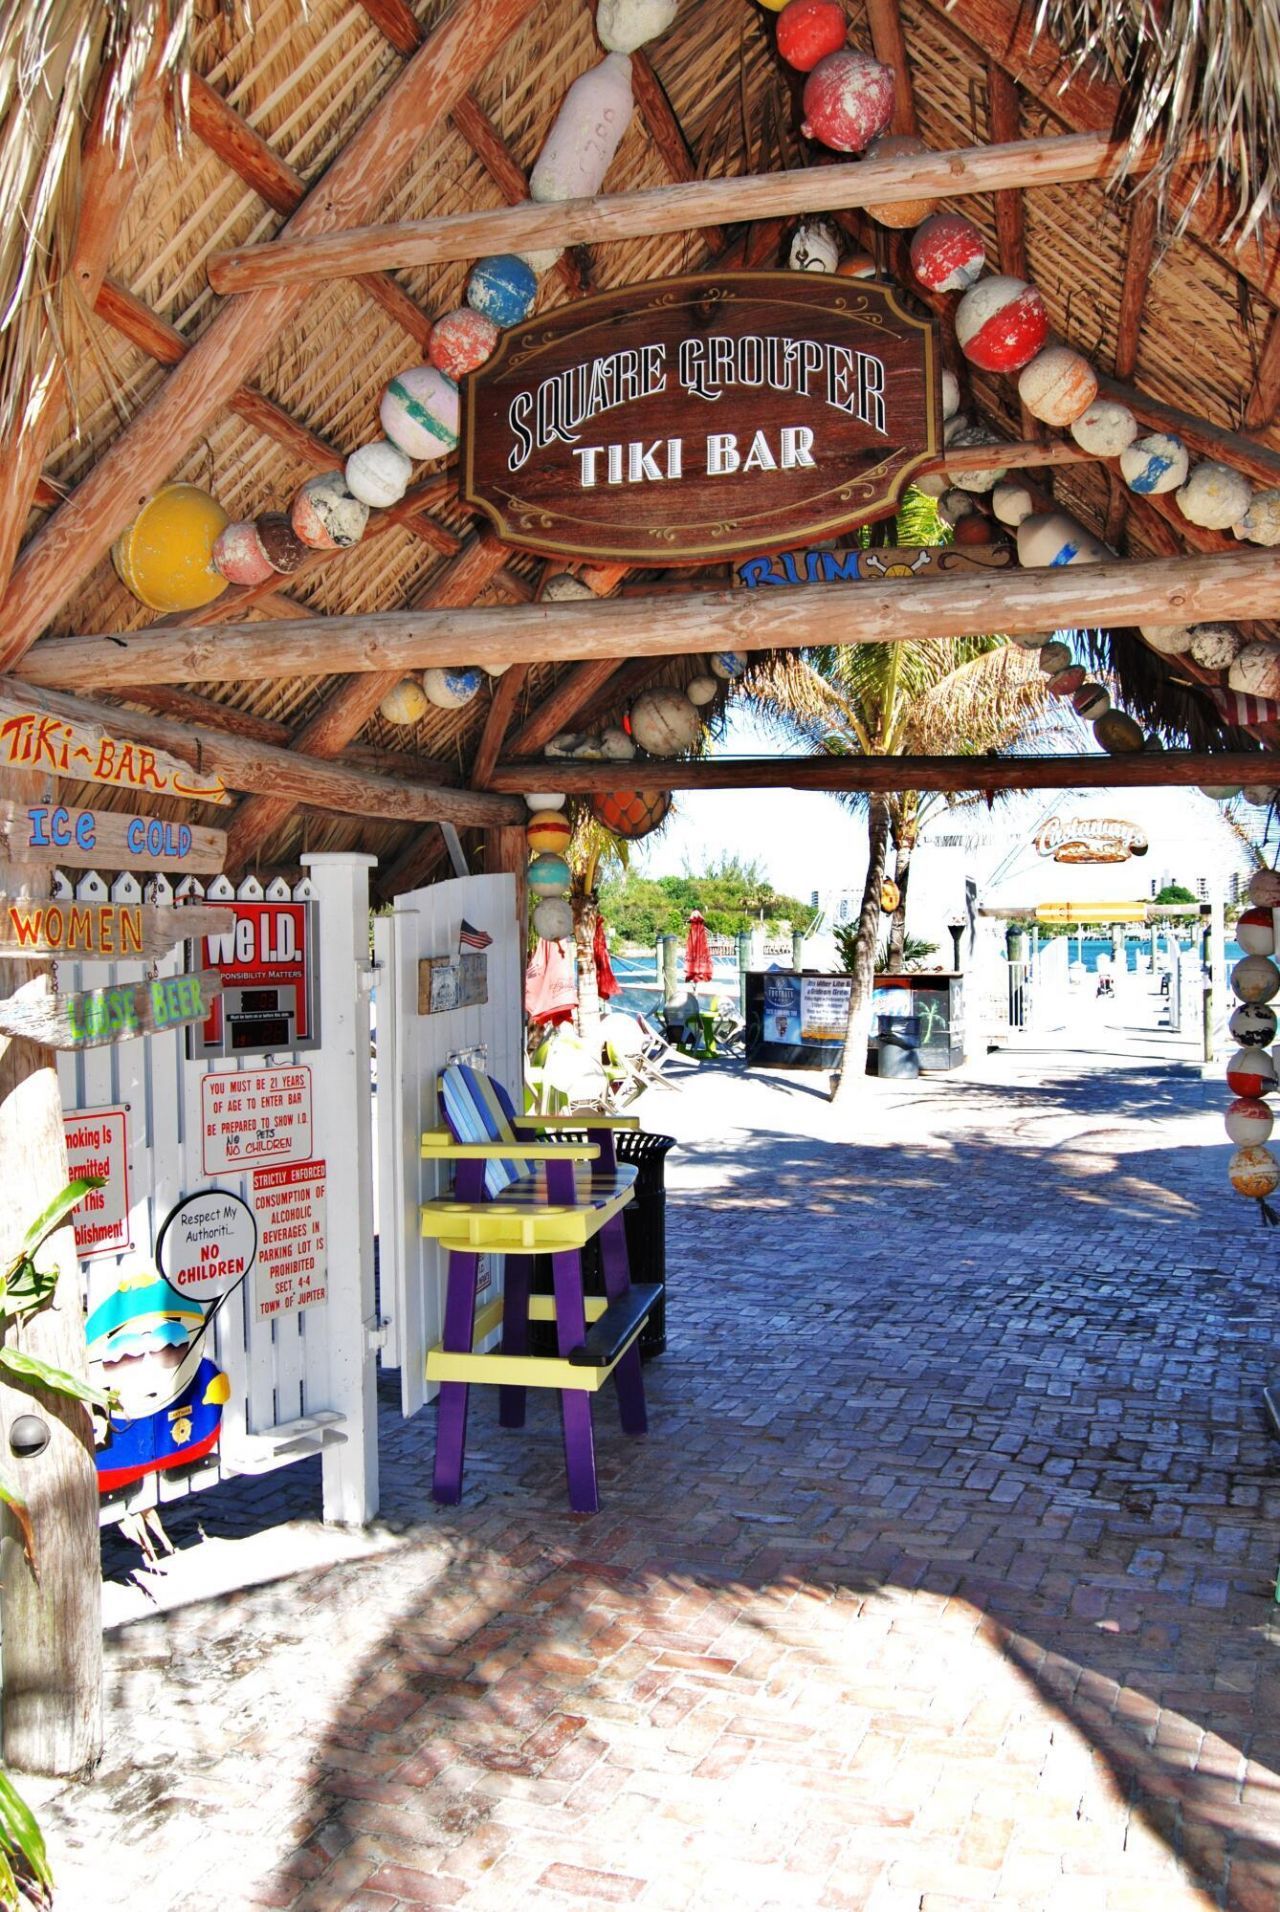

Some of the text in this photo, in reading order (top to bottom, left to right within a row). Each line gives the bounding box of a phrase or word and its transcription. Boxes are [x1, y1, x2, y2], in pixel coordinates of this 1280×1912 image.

[508, 336, 888, 471] SQUARE GROUPER
[573, 426, 816, 487] TIKI BAR
[736, 551, 861, 588] RUM
[127, 817, 192, 860] COLD
[9, 907, 143, 953] WOMEN
[207, 912, 255, 965] We
[260, 912, 303, 963] I.D.
[220, 972, 266, 980] PONSIBILITY
[67, 979, 206, 1041] LOOSE BEER
[210, 1074, 305, 1095] YOU MUST BE 21 YEARS
[213, 1093, 302, 1114] OF AGE TO ENTER BAR
[65, 1124, 112, 1149] moking Is
[207, 1124, 216, 1136] BE
[221, 1119, 257, 1134] PREPARED
[261, 1117, 270, 1128] TO
[274, 1114, 294, 1128] SHOW
[256, 1129, 275, 1140] PETS
[226, 1137, 292, 1156] NO CHILDREN
[68, 1156, 110, 1182] ermitted
[254, 1165, 326, 1188] STRICTLY ENFORCED
[85, 1189, 105, 1212] This
[255, 1185, 325, 1210] CONSUMPTION OF
[181, 1206, 237, 1226] Respect My
[271, 1206, 312, 1225] ALCOHOLIC
[74, 1218, 123, 1246] blishment
[263, 1221, 320, 1244] BEVERAGES IN
[201, 1244, 219, 1262] NO
[259, 1238, 324, 1263] PARKING LOT IS
[177, 1256, 244, 1285] CHILDREN
[270, 1257, 315, 1279] PROHIBITED
[260, 1288, 325, 1314] TOWN OF JUPITER
